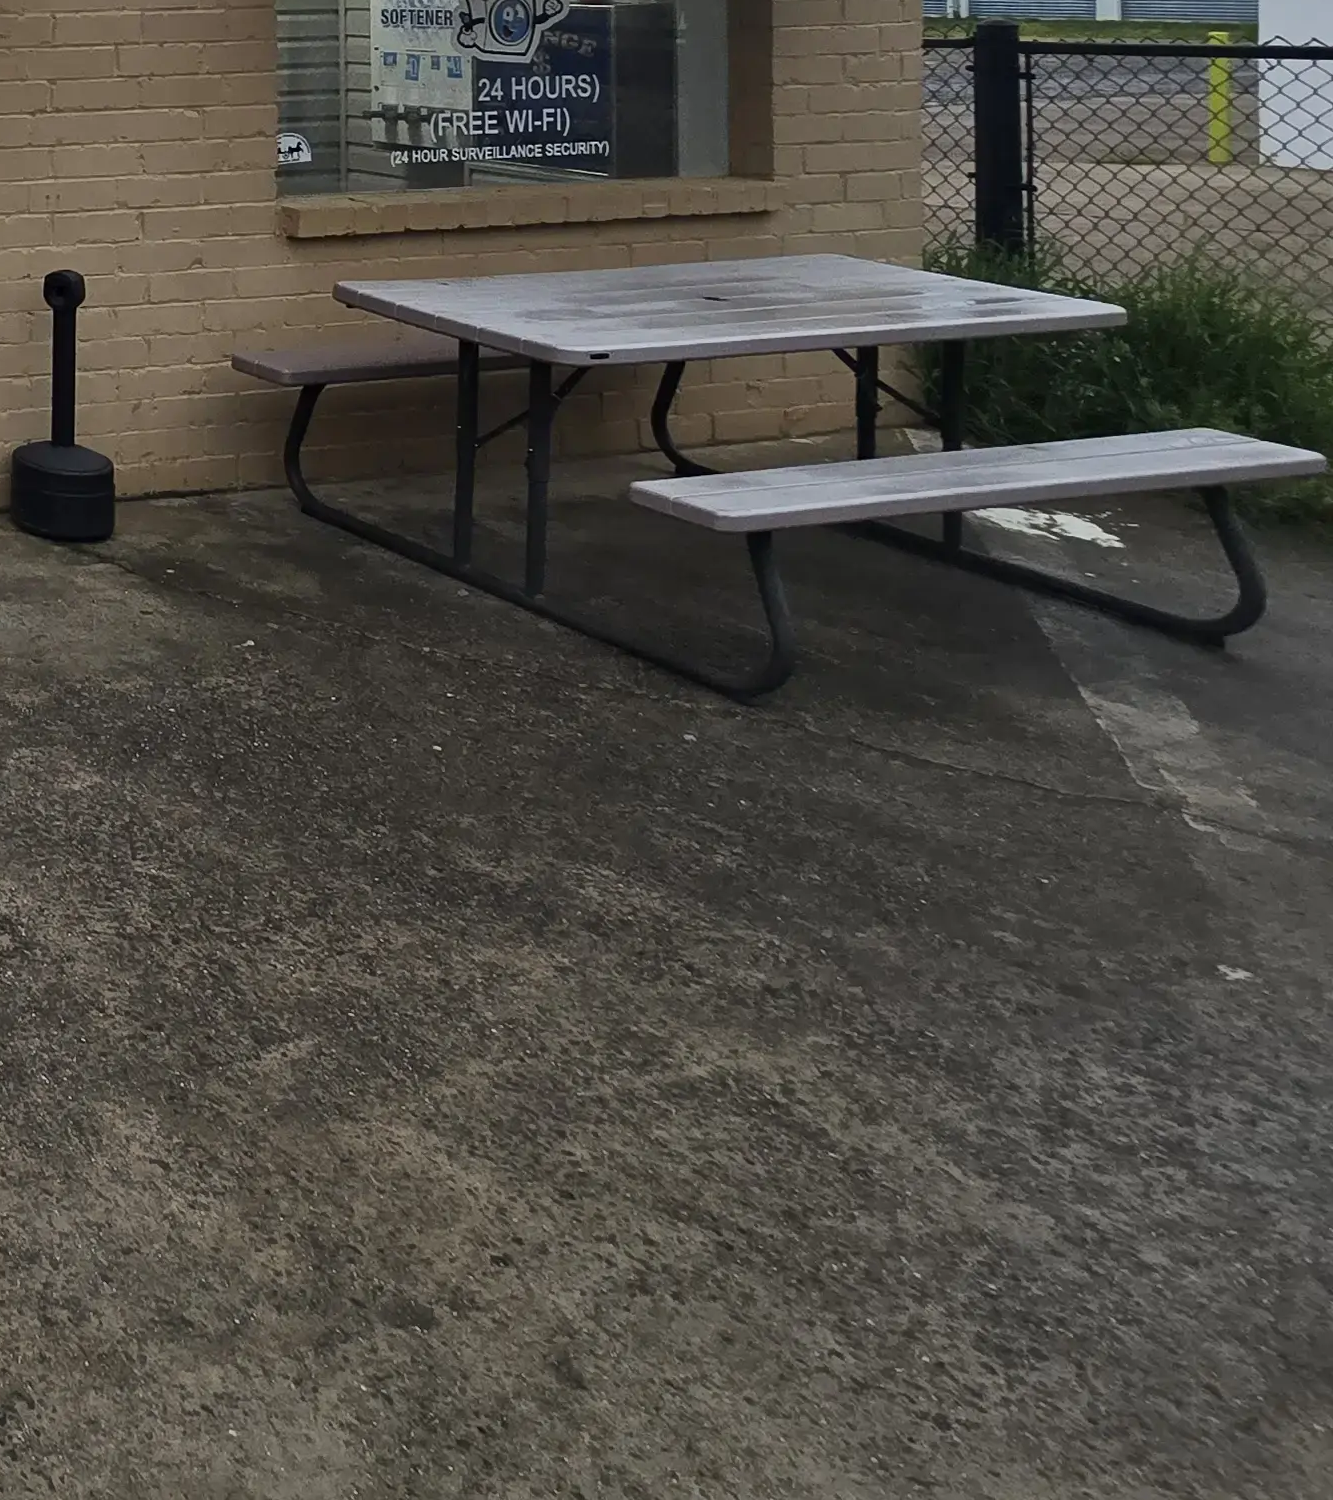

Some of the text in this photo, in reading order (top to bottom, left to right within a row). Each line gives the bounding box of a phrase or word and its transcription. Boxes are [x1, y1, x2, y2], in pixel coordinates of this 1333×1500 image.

[380, 8, 454, 26] SOFTENER
[478, 74, 601, 104] 24 HOURS)
[429, 107, 571, 143] (FREE WI-FI)
[390, 140, 610, 168] (24 HOUR SURVEILLANCE SECURITY)
